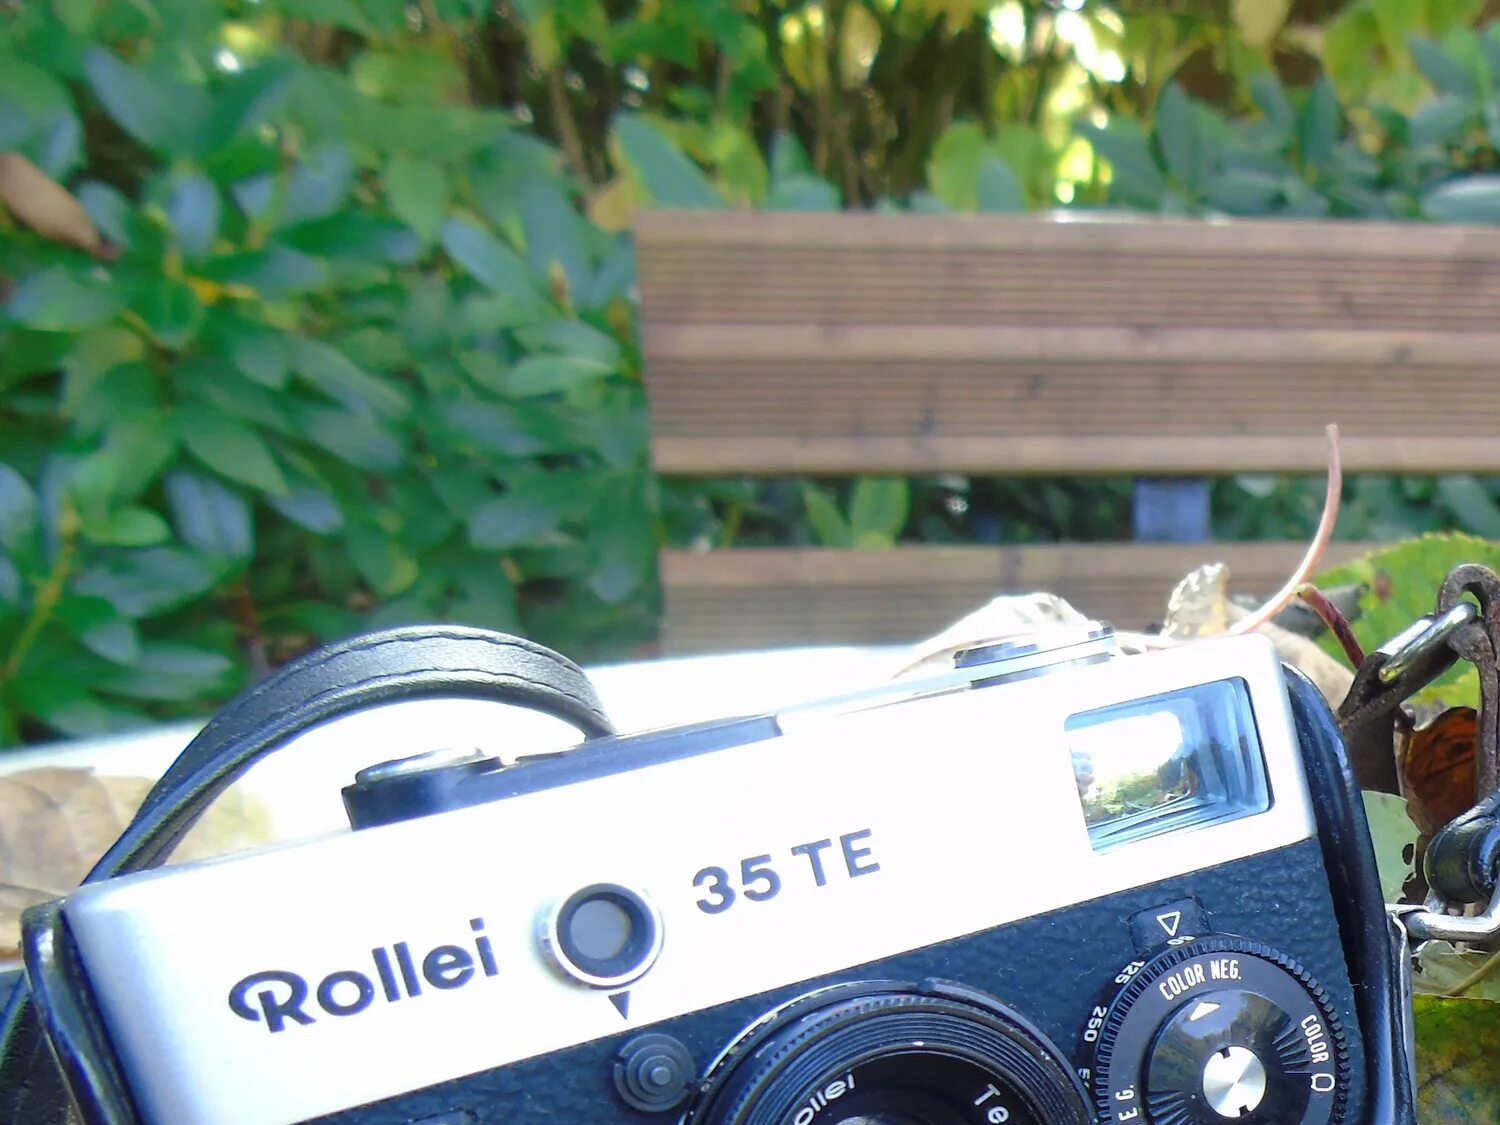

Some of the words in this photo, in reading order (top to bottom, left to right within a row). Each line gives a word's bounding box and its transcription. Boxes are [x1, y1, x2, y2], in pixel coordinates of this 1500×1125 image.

[692, 854, 782, 914] 35
[791, 828, 881, 887] TE
[227, 917, 499, 1032] Rollei
[1113, 959, 1146, 986] 125
[1159, 963, 1206, 1001] COLOR
[1210, 959, 1242, 981] NEG.
[1083, 1005, 1107, 1042] 250
[1300, 1014, 1330, 1064] COLOR
